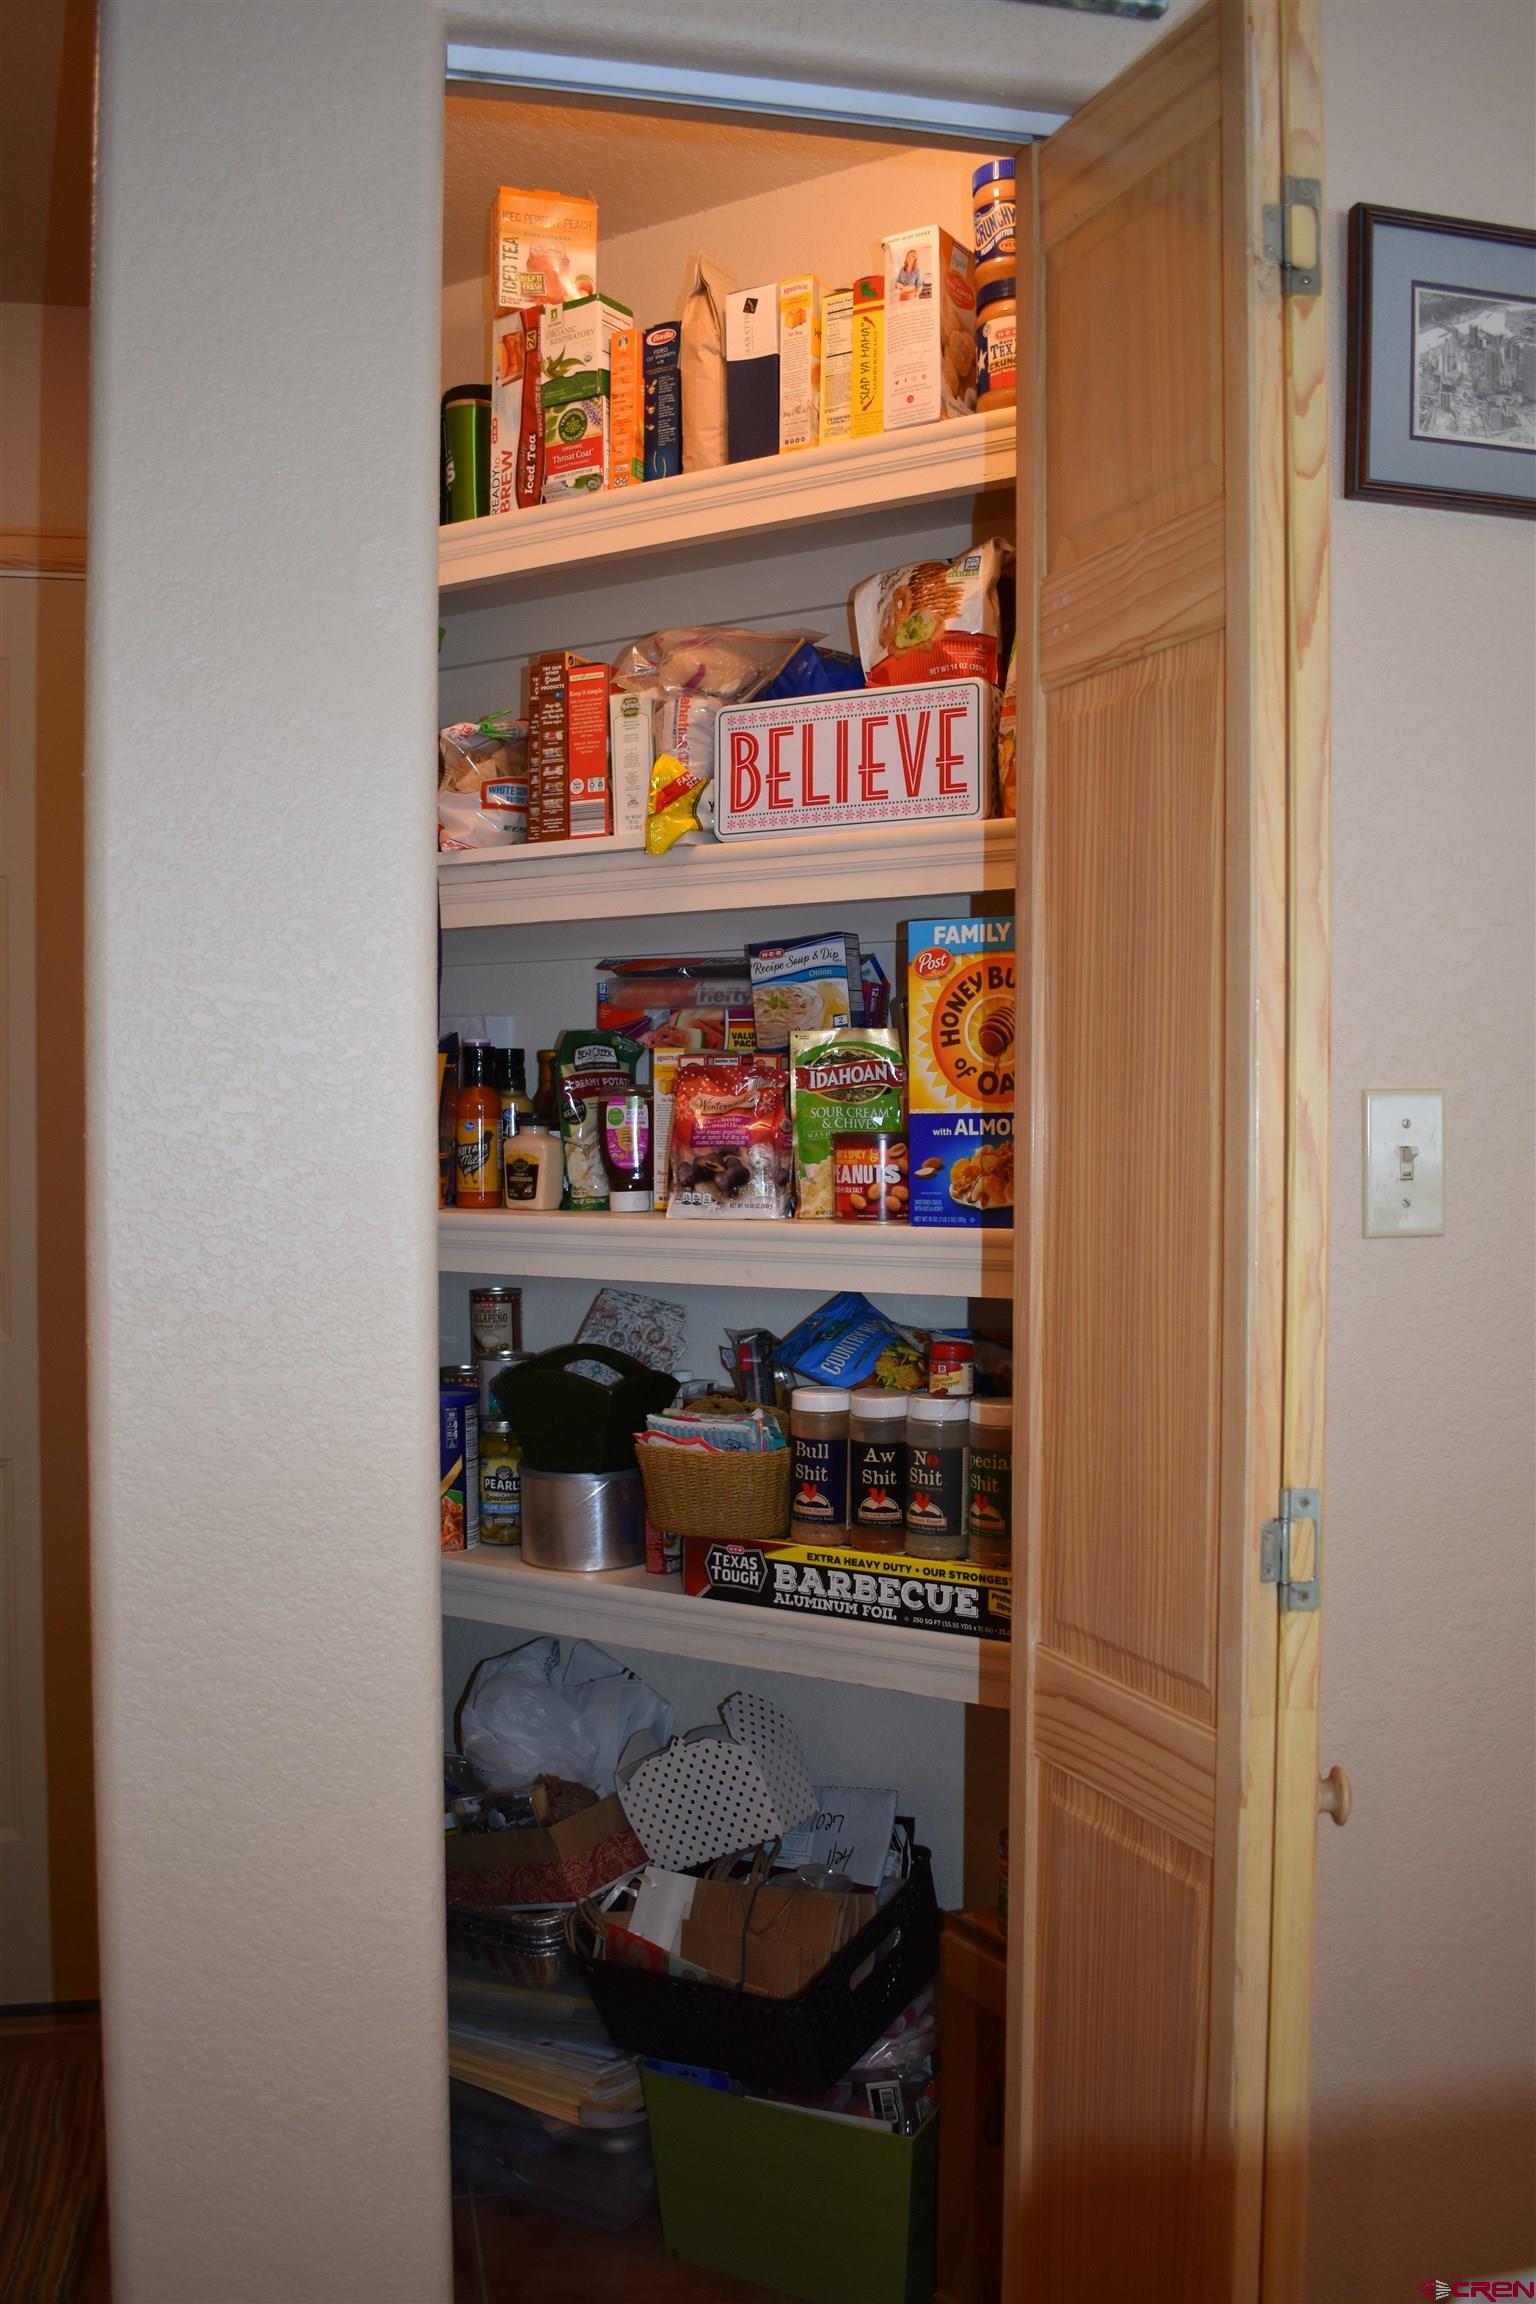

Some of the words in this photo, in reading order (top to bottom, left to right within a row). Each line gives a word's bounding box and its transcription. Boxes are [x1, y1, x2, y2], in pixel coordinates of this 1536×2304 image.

[502, 237, 519, 260] TEA
[502, 264, 518, 294] ICED
[526, 433, 537, 462] Tea
[552, 453, 575, 464] Throat
[576, 450, 594, 460] Coat
[500, 450, 513, 513] BREW
[524, 465, 536, 494] Iced
[730, 706, 968, 814] BELIEVE
[934, 922, 1012, 946] FAMILY
[753, 960, 786, 976] Recipe
[786, 954, 810, 969] Soup
[820, 948, 839, 962] Dip
[808, 968, 832, 976] Onion
[918, 952, 948, 974] Post
[838, 1016, 844, 1024] 2
[940, 971, 983, 1048] HONEY
[810, 1064, 888, 1088] IDAHOAN
[954, 1058, 978, 1078] of
[978, 1070, 1016, 1096] OA
[810, 1106, 844, 1118] SOUR
[846, 1106, 889, 1118] CREAM
[822, 1118, 832, 1129] &
[834, 1118, 878, 1130] CHIVES
[932, 1128, 952, 1136] with
[954, 1118, 1014, 1136] ALMO
[820, 1330, 868, 1376] COUNTRY
[796, 1440, 830, 1459] Bull
[864, 1448, 896, 1464] Aw
[795, 1463, 828, 1482] Shit
[862, 1469, 897, 1486] Shit
[910, 1466, 943, 1486] Shit
[970, 1473, 1000, 1493] Shit
[712, 1551, 758, 1570] TEXAS
[806, 1552, 842, 1566] EXTRA
[844, 1557, 881, 1570] HEAVY
[883, 1562, 912, 1574] DUTY
[923, 1566, 946, 1578] OUR
[710, 1565, 760, 1586] TOUGH
[774, 1562, 980, 1619] BARBECUE
[774, 1592, 860, 1615] ALUMINUM
[862, 1604, 898, 1621] FOIL
